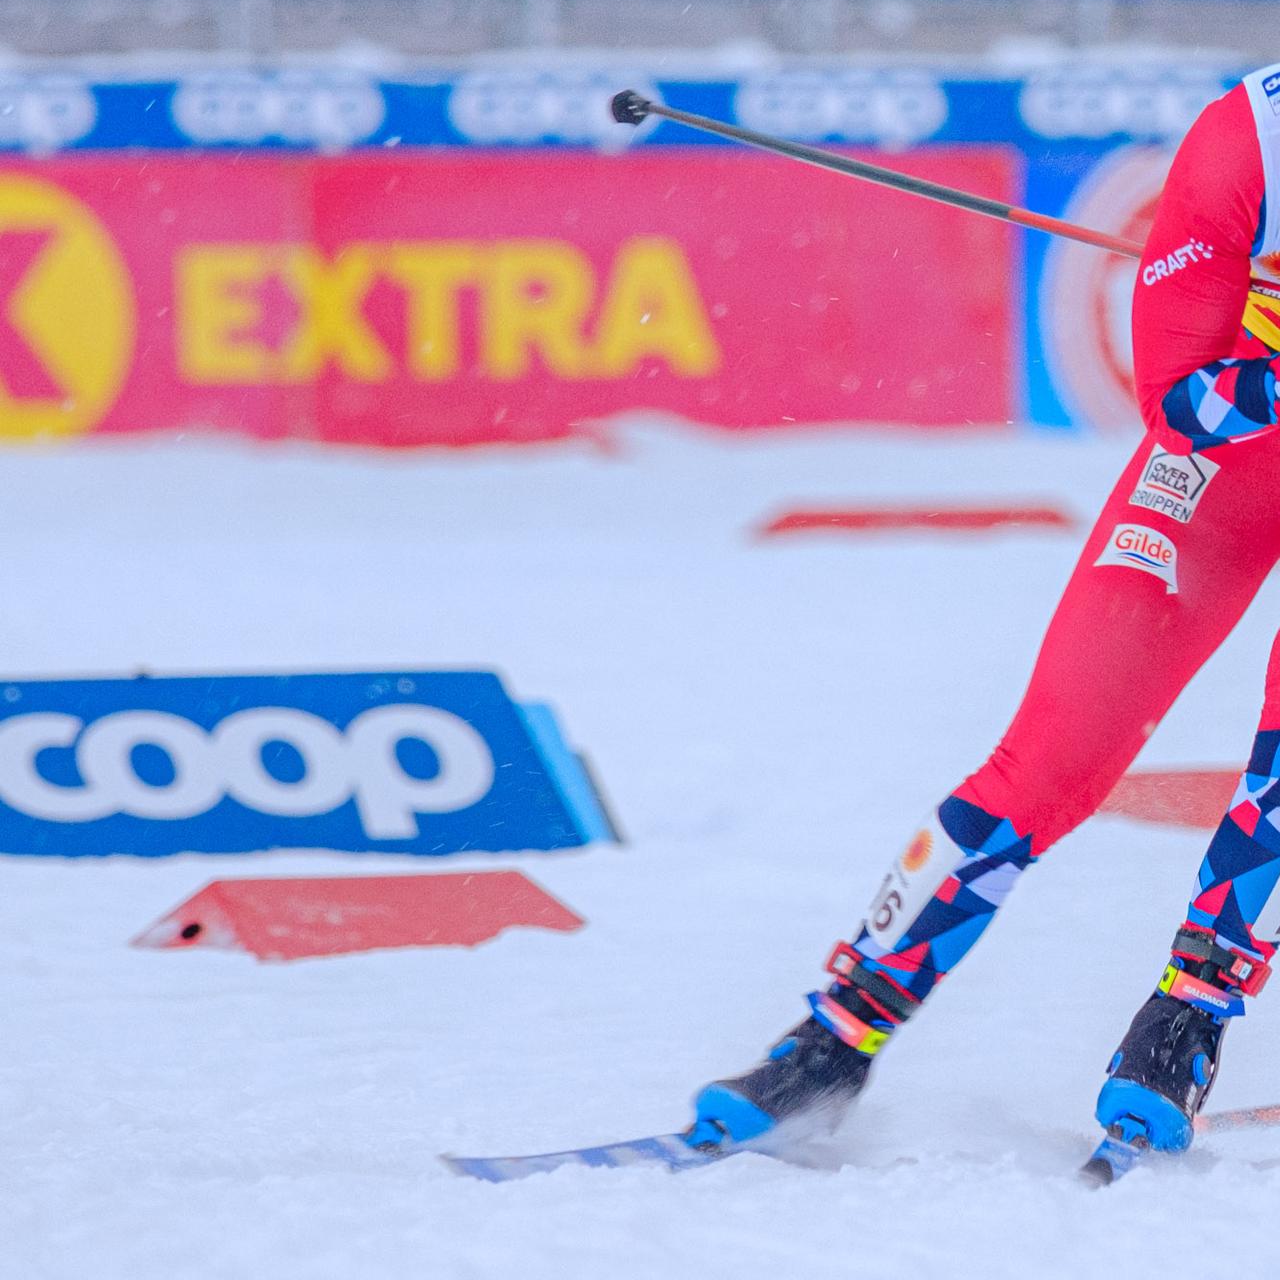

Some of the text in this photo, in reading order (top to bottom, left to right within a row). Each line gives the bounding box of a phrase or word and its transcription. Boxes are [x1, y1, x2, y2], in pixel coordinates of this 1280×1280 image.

[1142, 243, 1198, 286] CRAFT
[178, 237, 720, 382] EXTRA
[1150, 471, 1189, 495] HALLA
[1154, 462, 1190, 482] OVER
[1131, 489, 1193, 523] GRUPPEN
[1115, 528, 1173, 564] Gilde
[0, 704, 494, 840] coop
